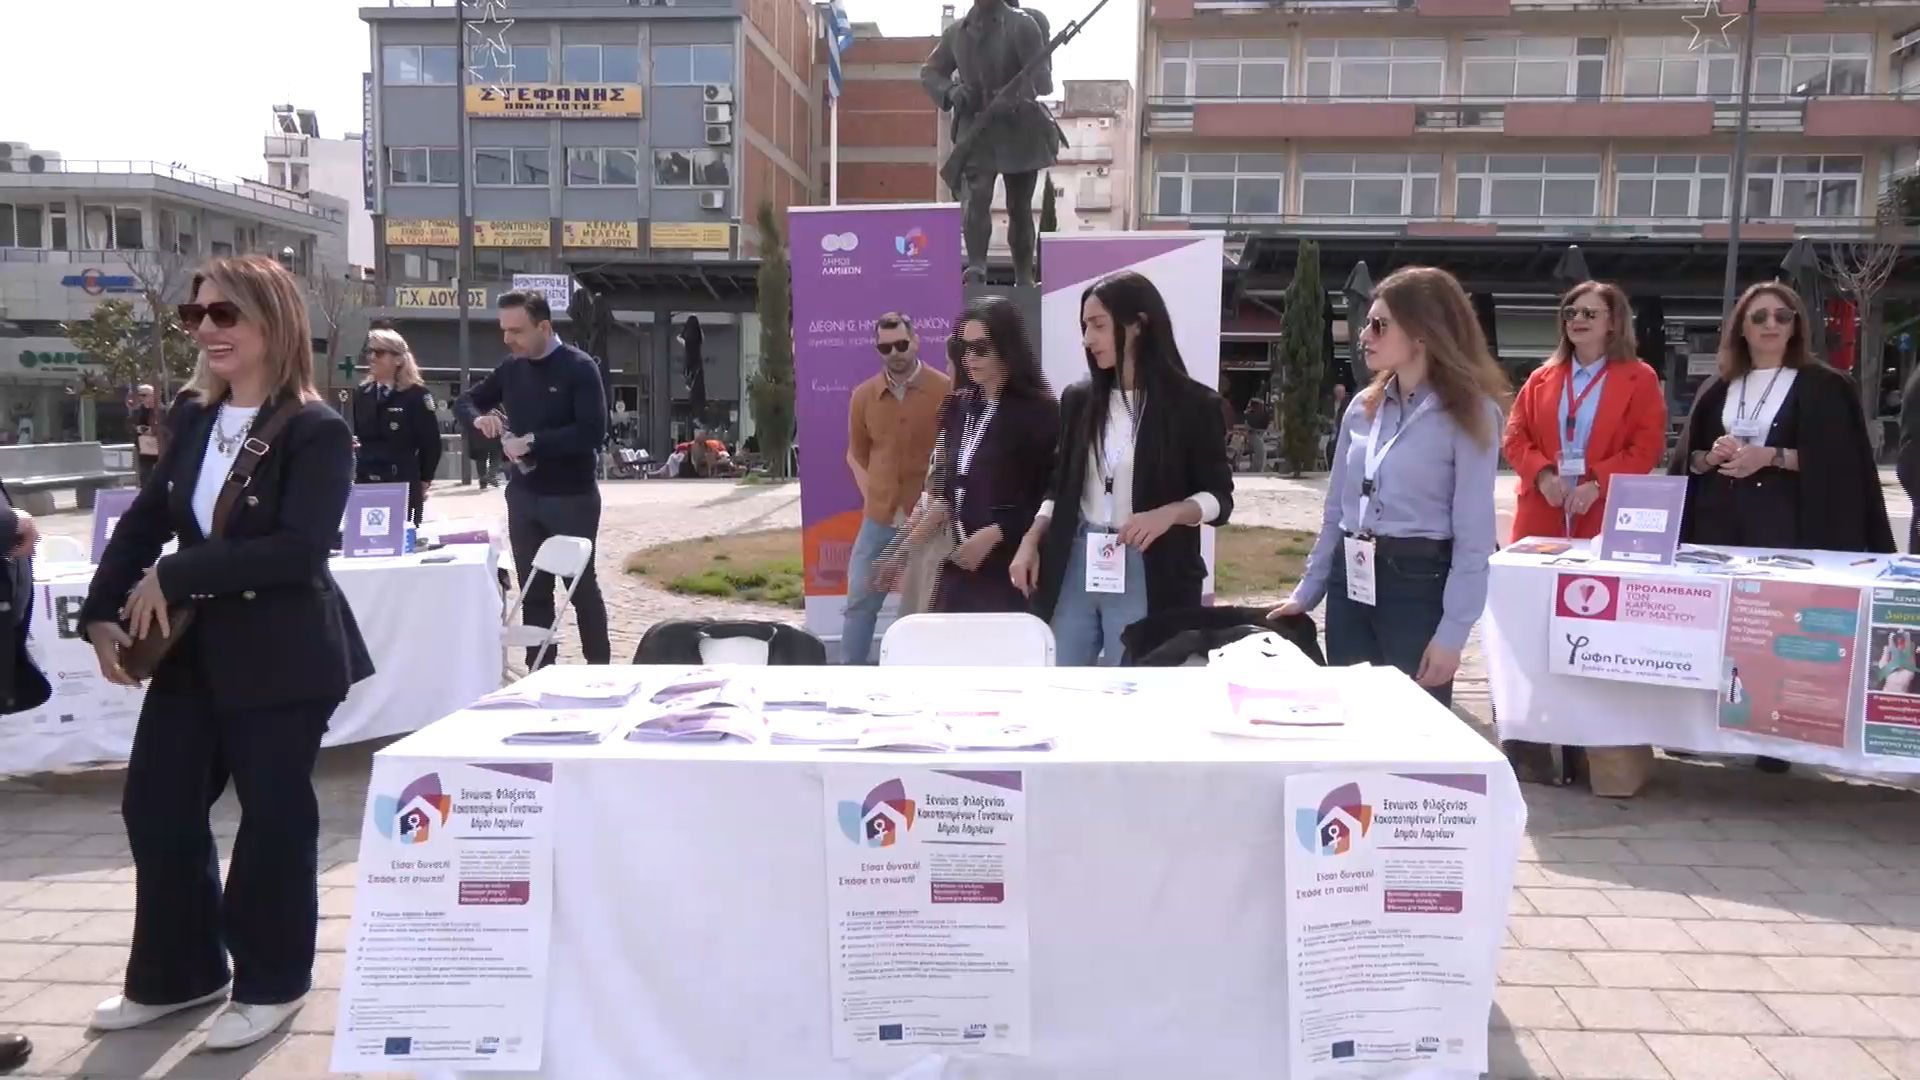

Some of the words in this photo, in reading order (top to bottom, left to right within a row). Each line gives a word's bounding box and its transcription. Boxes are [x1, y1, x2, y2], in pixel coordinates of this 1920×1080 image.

[480, 87, 625, 101] ΣΤΕΦΑΝΗΣ
[428, 291, 484, 307] ΔΟΥΟΣ
[809, 319, 856, 332] ΔΙΕΘΝΗΣ
[1626, 584, 1712, 598] ΠΡΟΛΑΜΒΑΝΩ
[1625, 602, 1676, 612] ΚΑΡΚΙΝΟ
[1625, 610, 1647, 619] ΤΟΥ
[1650, 611, 1696, 622] ΜΑΣΤΟΥ
[1615, 655, 1692, 672] Γεννηματά
[926, 794, 959, 806] Ξενώνας
[962, 795, 1005, 810] Φιλοξενίας
[1383, 799, 1418, 810] Ξενώνας
[1422, 799, 1469, 814] Φιλοξενίας
[1373, 815, 1437, 828] Κακοποιημένων
[1437, 814, 1476, 825] Γυναικών
[861, 863, 884, 871] Είσαι
[885, 861, 921, 871] δυνατή!
[839, 877, 868, 886] Σπάσε
[882, 875, 916, 885] σιωπή!
[1340, 869, 1375, 880] δυνατή!
[1296, 888, 1322, 899] Σπάσε
[1324, 886, 1335, 896] τη
[1336, 885, 1369, 895] σιωπή!
